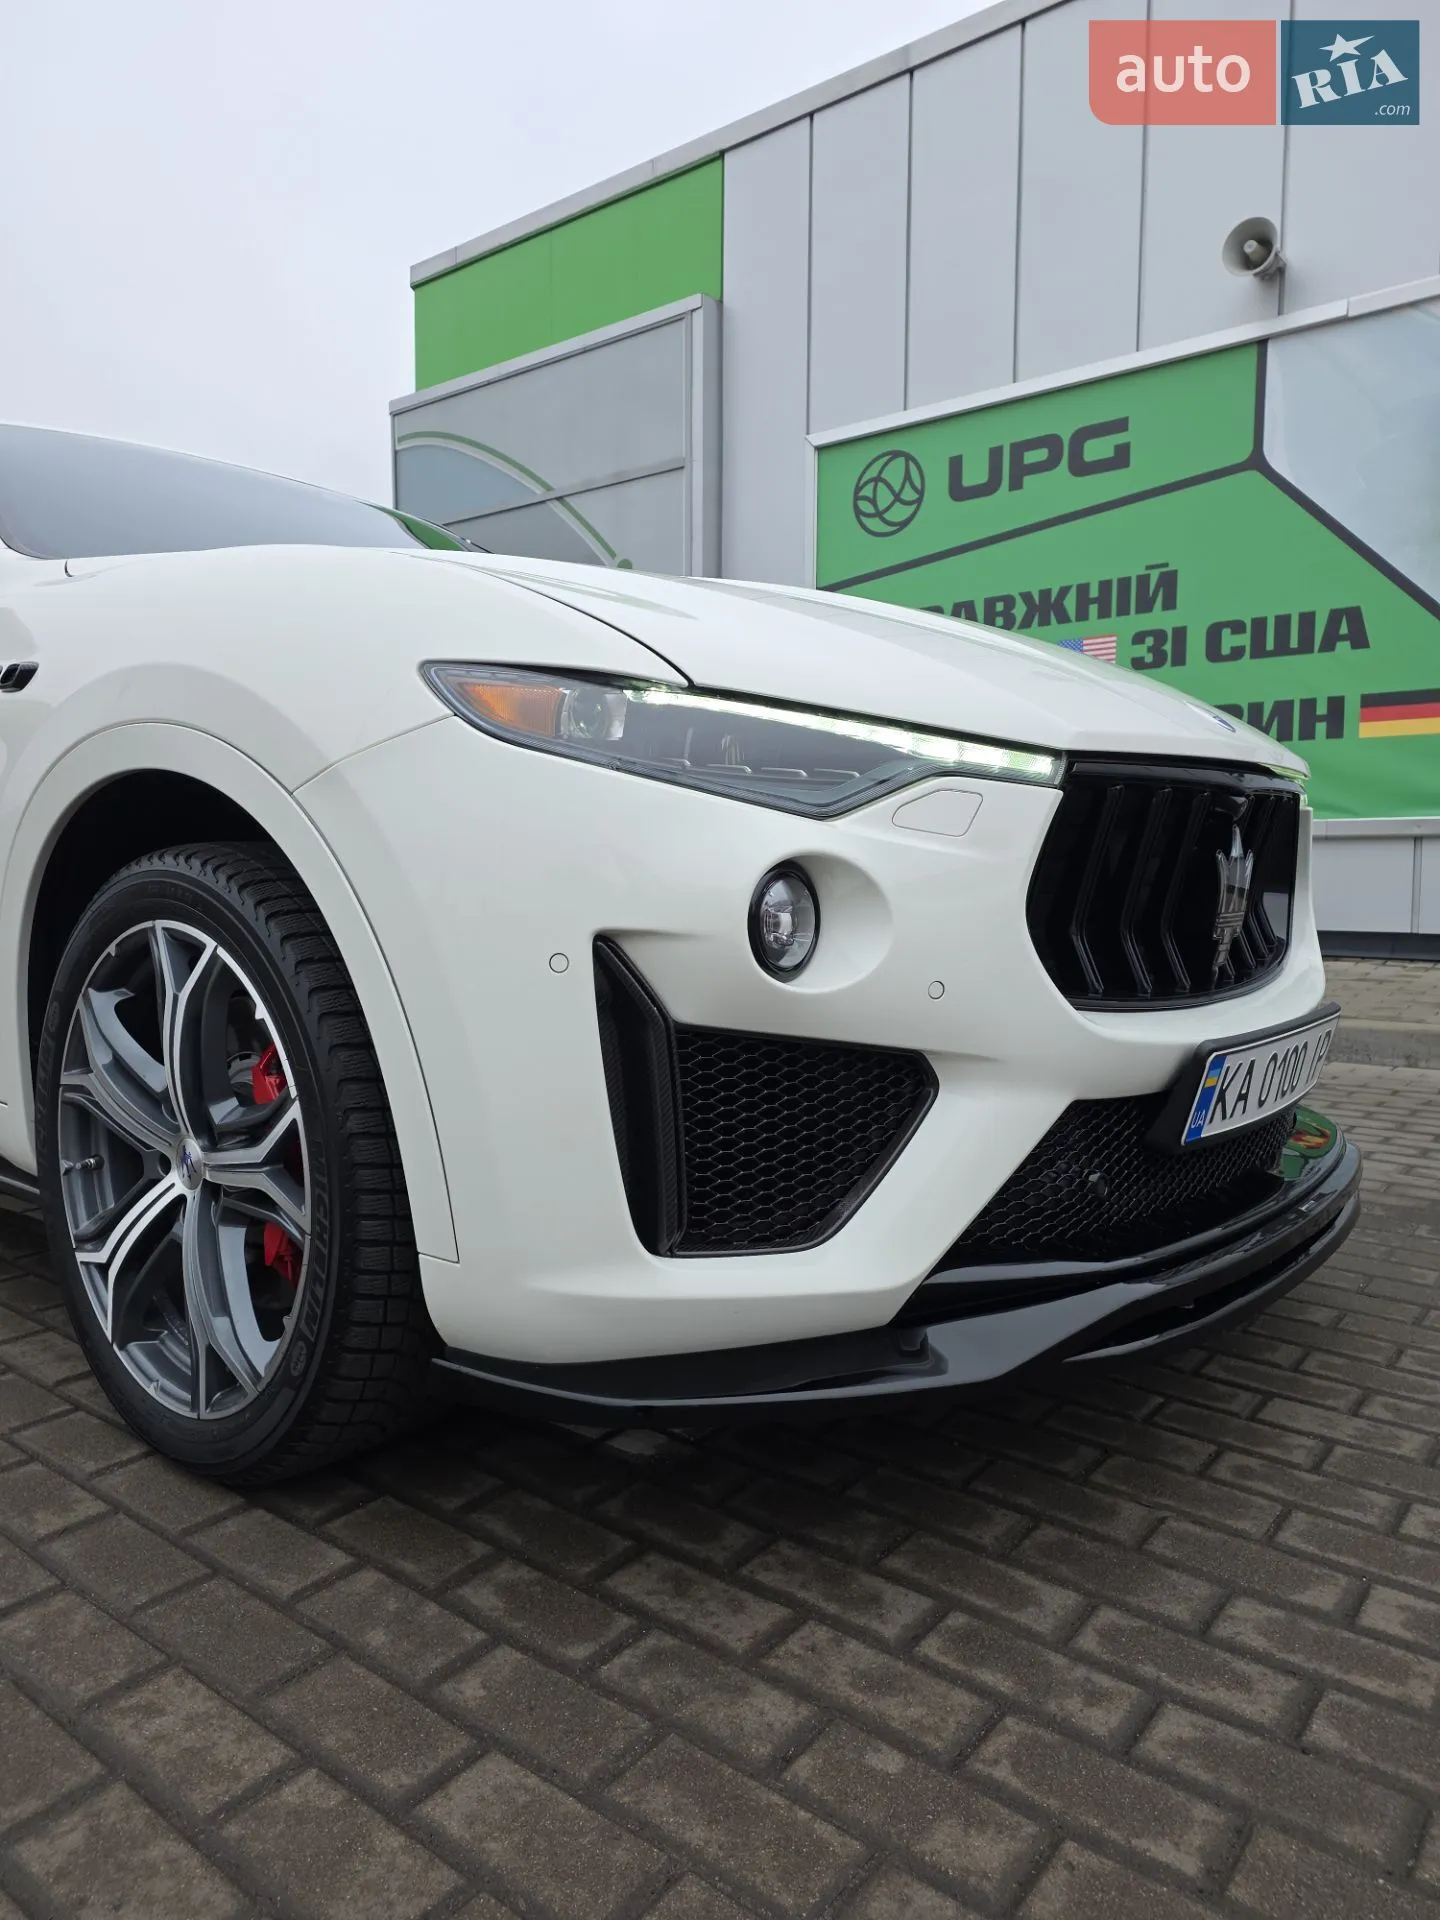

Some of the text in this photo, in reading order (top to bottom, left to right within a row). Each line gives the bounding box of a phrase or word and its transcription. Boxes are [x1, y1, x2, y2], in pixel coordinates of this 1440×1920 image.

[948, 416, 1131, 501] UPG
[920, 562, 1179, 632] АВЖНІЙ
[1130, 605, 1370, 671] ЗІ США
[1258, 1041, 1308, 1108] 0100
[1191, 1109, 1206, 1129] UA
